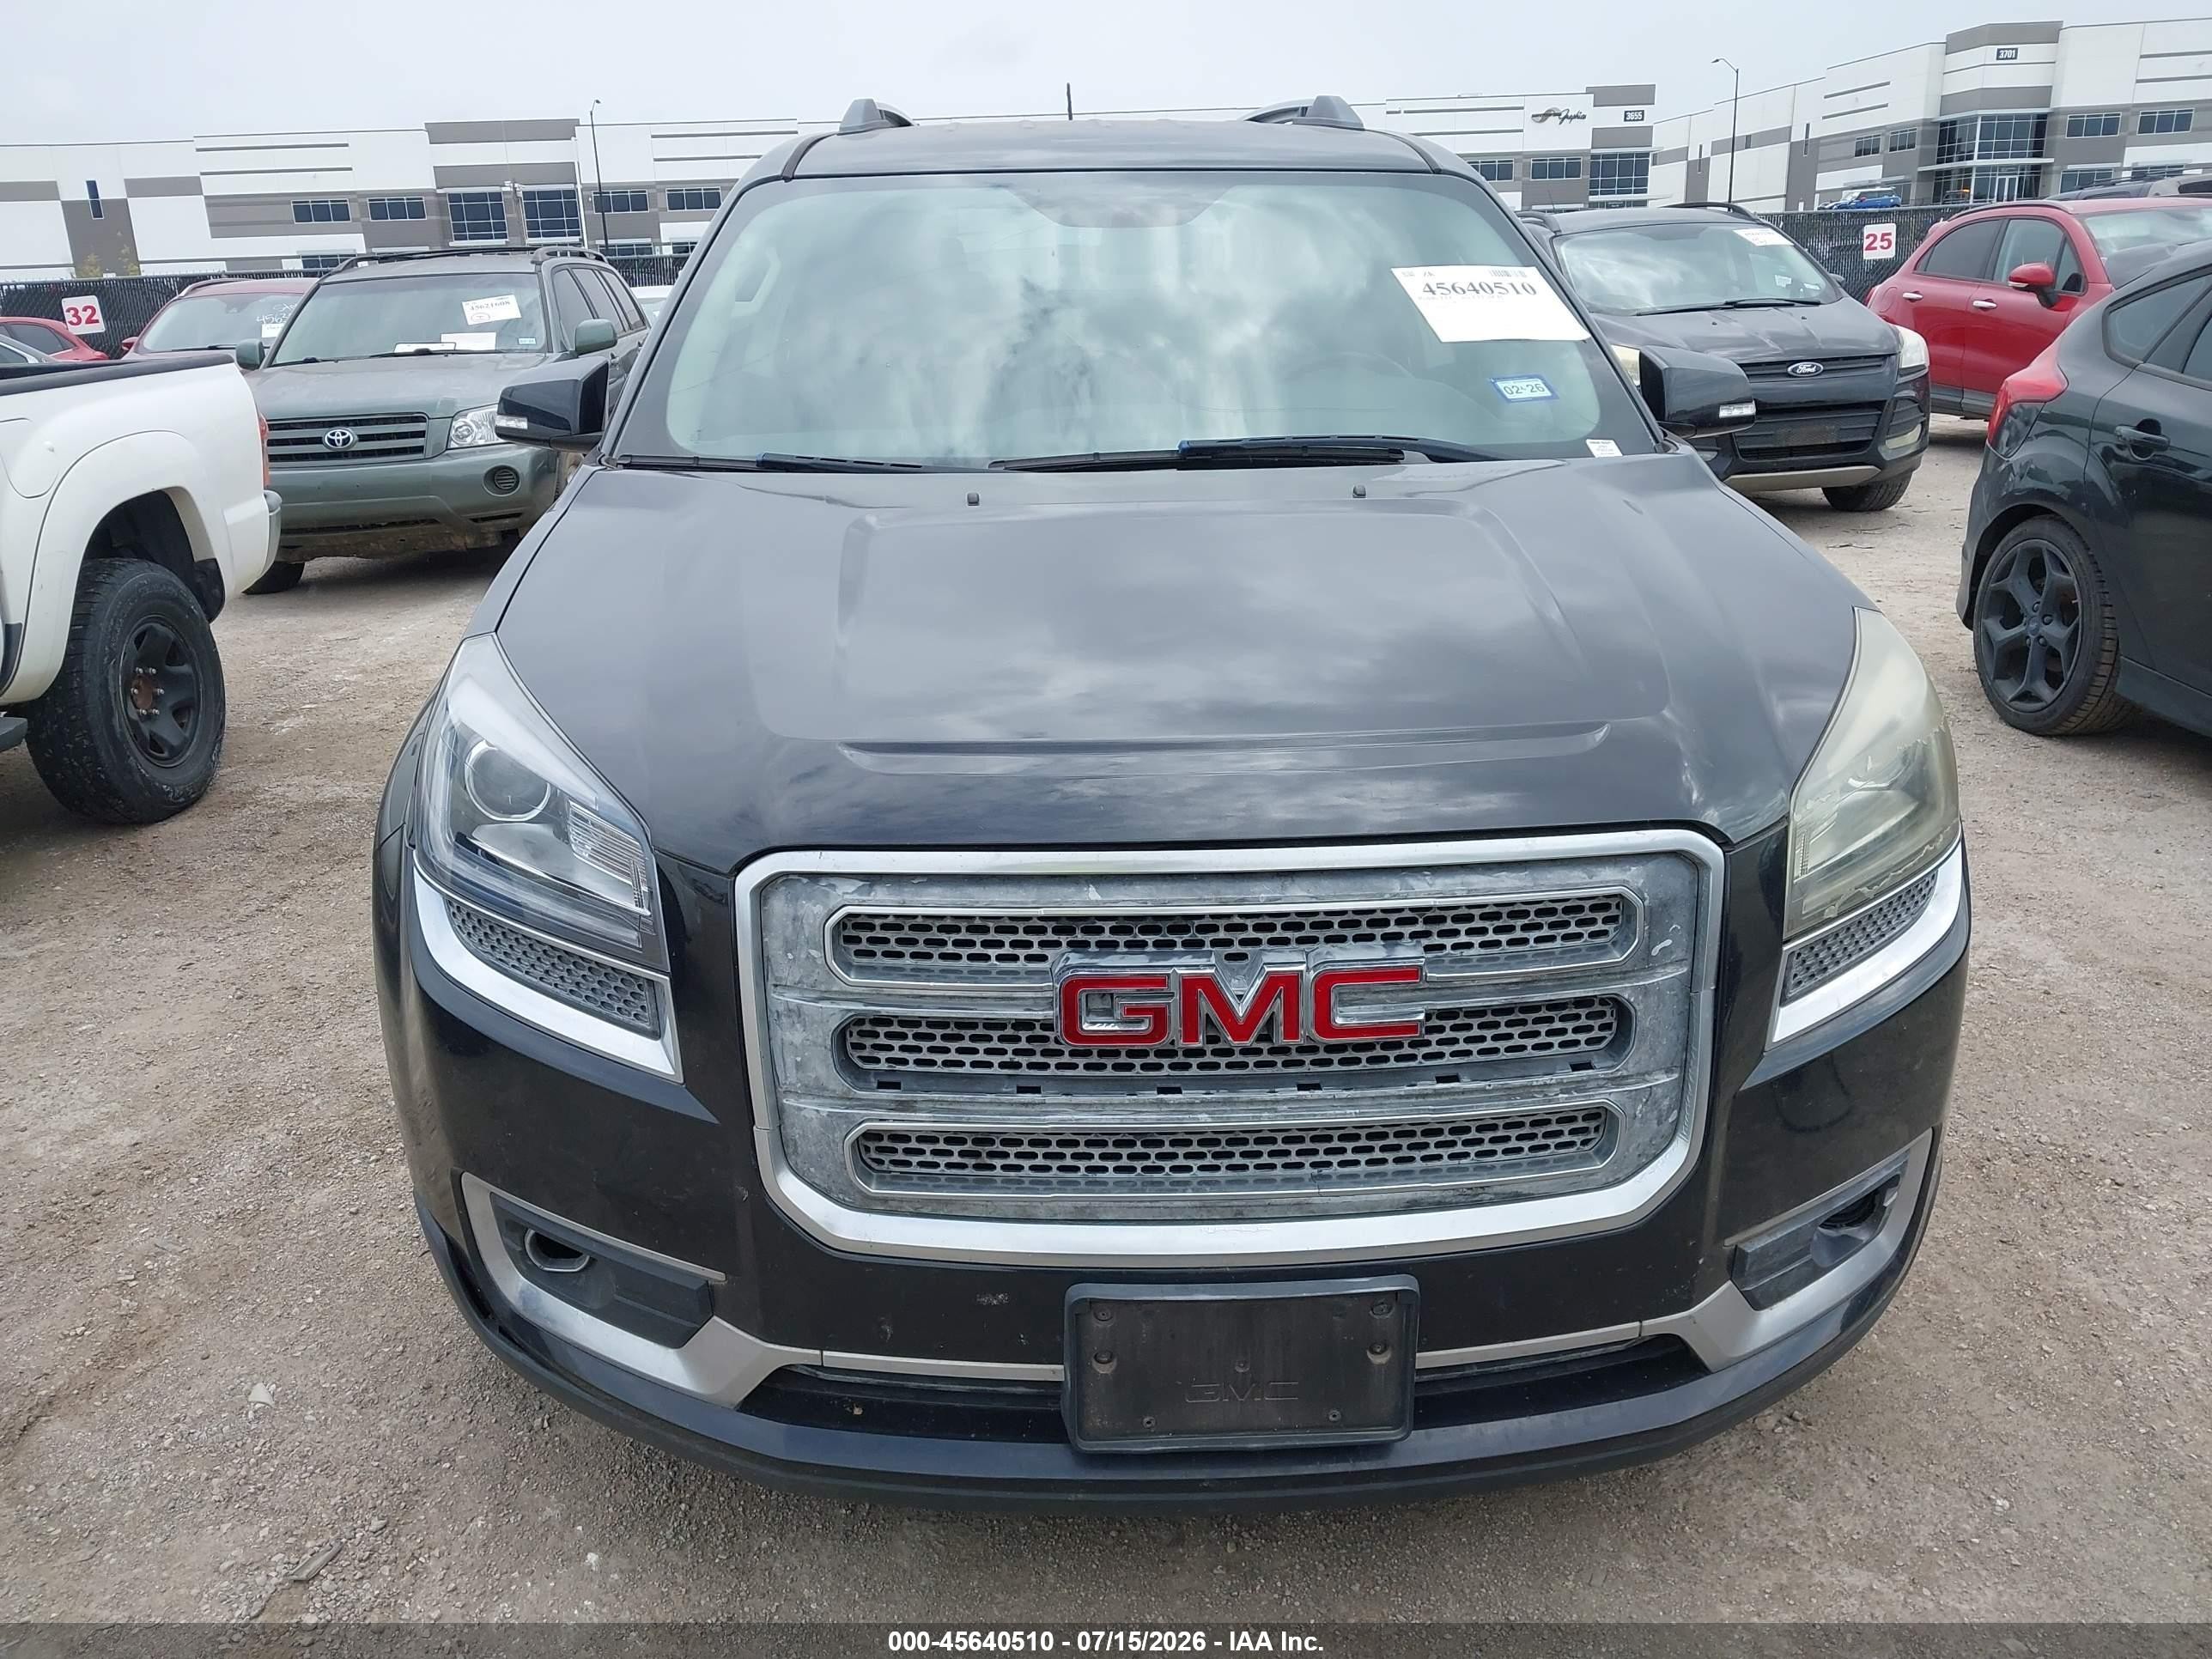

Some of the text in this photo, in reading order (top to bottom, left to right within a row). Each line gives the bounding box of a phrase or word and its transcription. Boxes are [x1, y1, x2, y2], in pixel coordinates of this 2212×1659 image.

[1999, 49, 2015, 58] 3701
[1626, 112, 1643, 120] 3655
[1864, 232, 1892, 251] 25
[1422, 281, 1537, 295] 45640510
[65, 305, 100, 325] 32
[1796, 364, 1817, 374] Ford
[1056, 958, 1424, 1047] GMC
[1185, 1381, 1299, 1403] GMC
